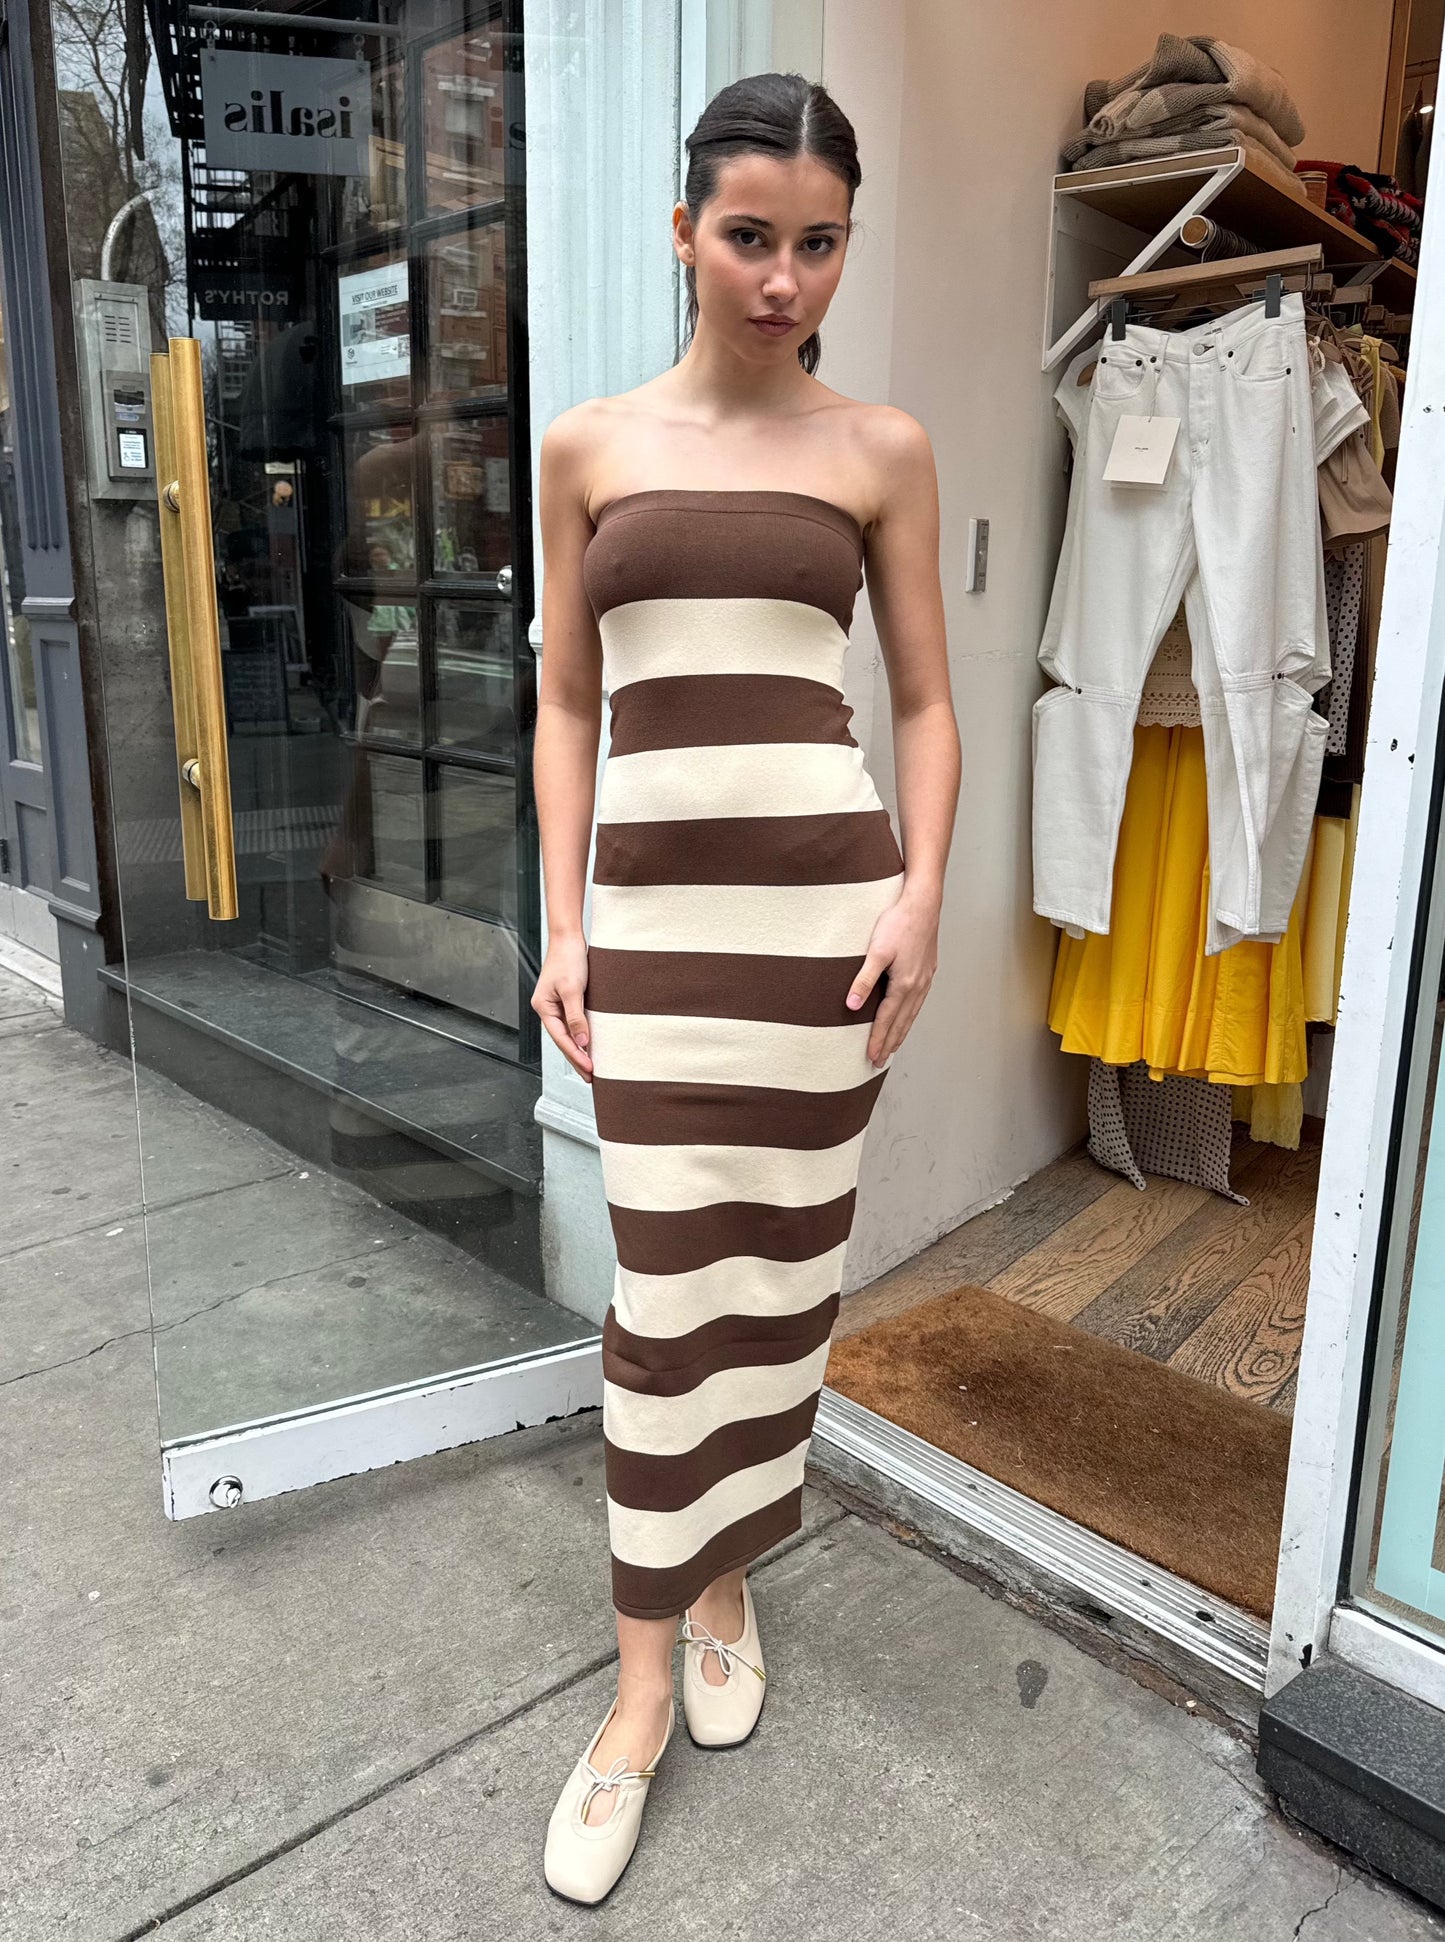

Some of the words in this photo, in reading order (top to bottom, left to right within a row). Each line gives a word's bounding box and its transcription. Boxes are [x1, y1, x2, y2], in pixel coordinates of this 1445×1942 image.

[352, 293, 364, 303] VISIT
[365, 291, 376, 300] OUR
[376, 284, 398, 297] WEBSITE
